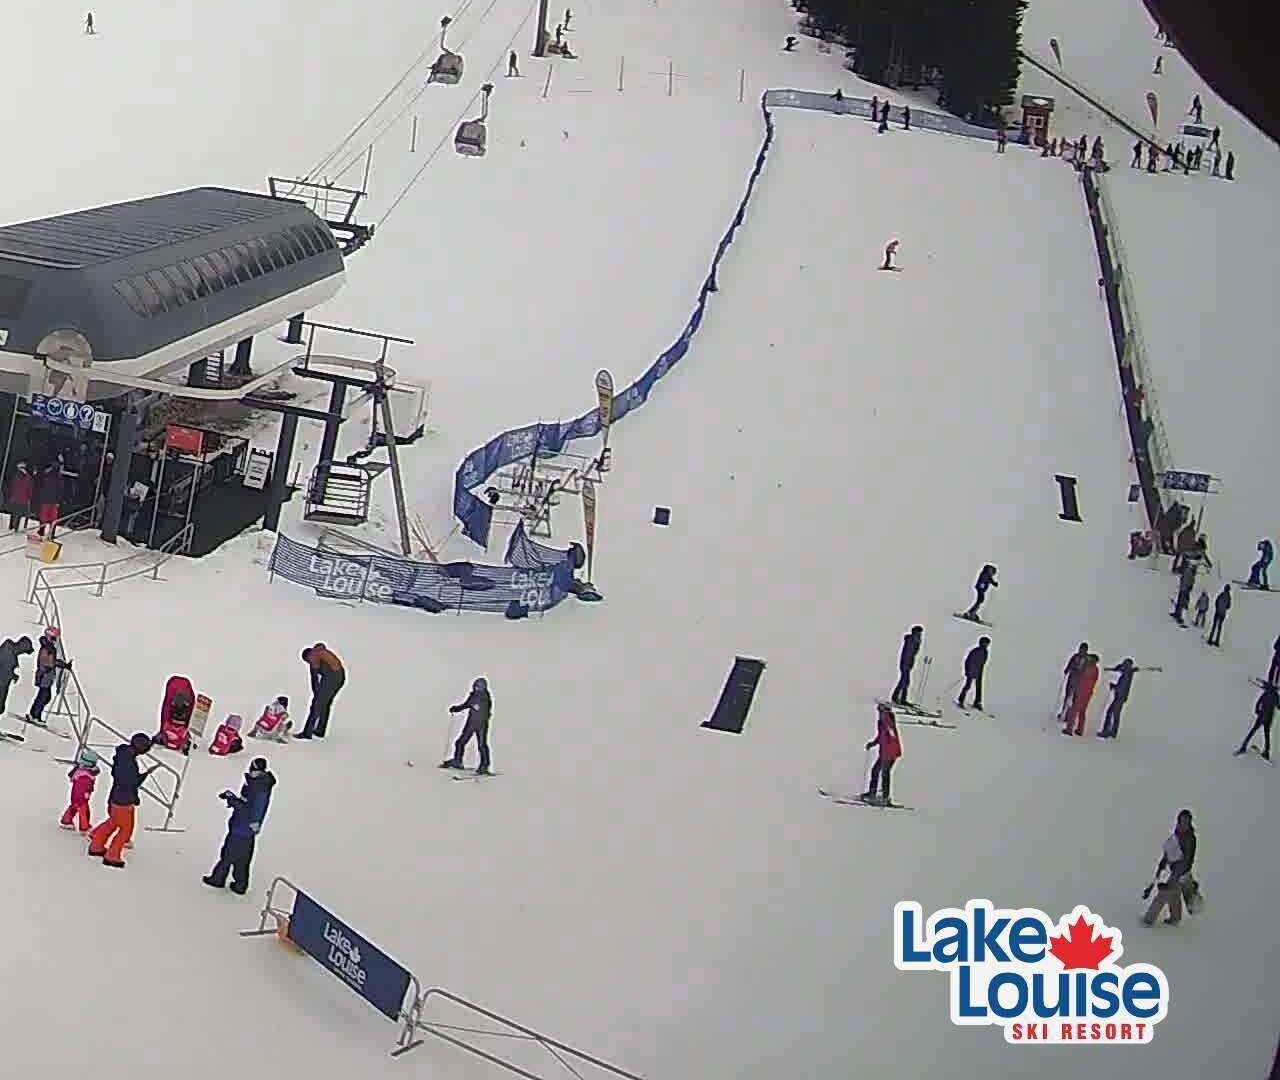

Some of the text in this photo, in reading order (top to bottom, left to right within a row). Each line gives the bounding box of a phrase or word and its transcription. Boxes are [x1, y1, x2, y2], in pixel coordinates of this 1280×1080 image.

[310, 555, 361, 576] Lake
[512, 570, 547, 588] Lake
[323, 921, 352, 954] Lake
[327, 944, 366, 985] Louise
